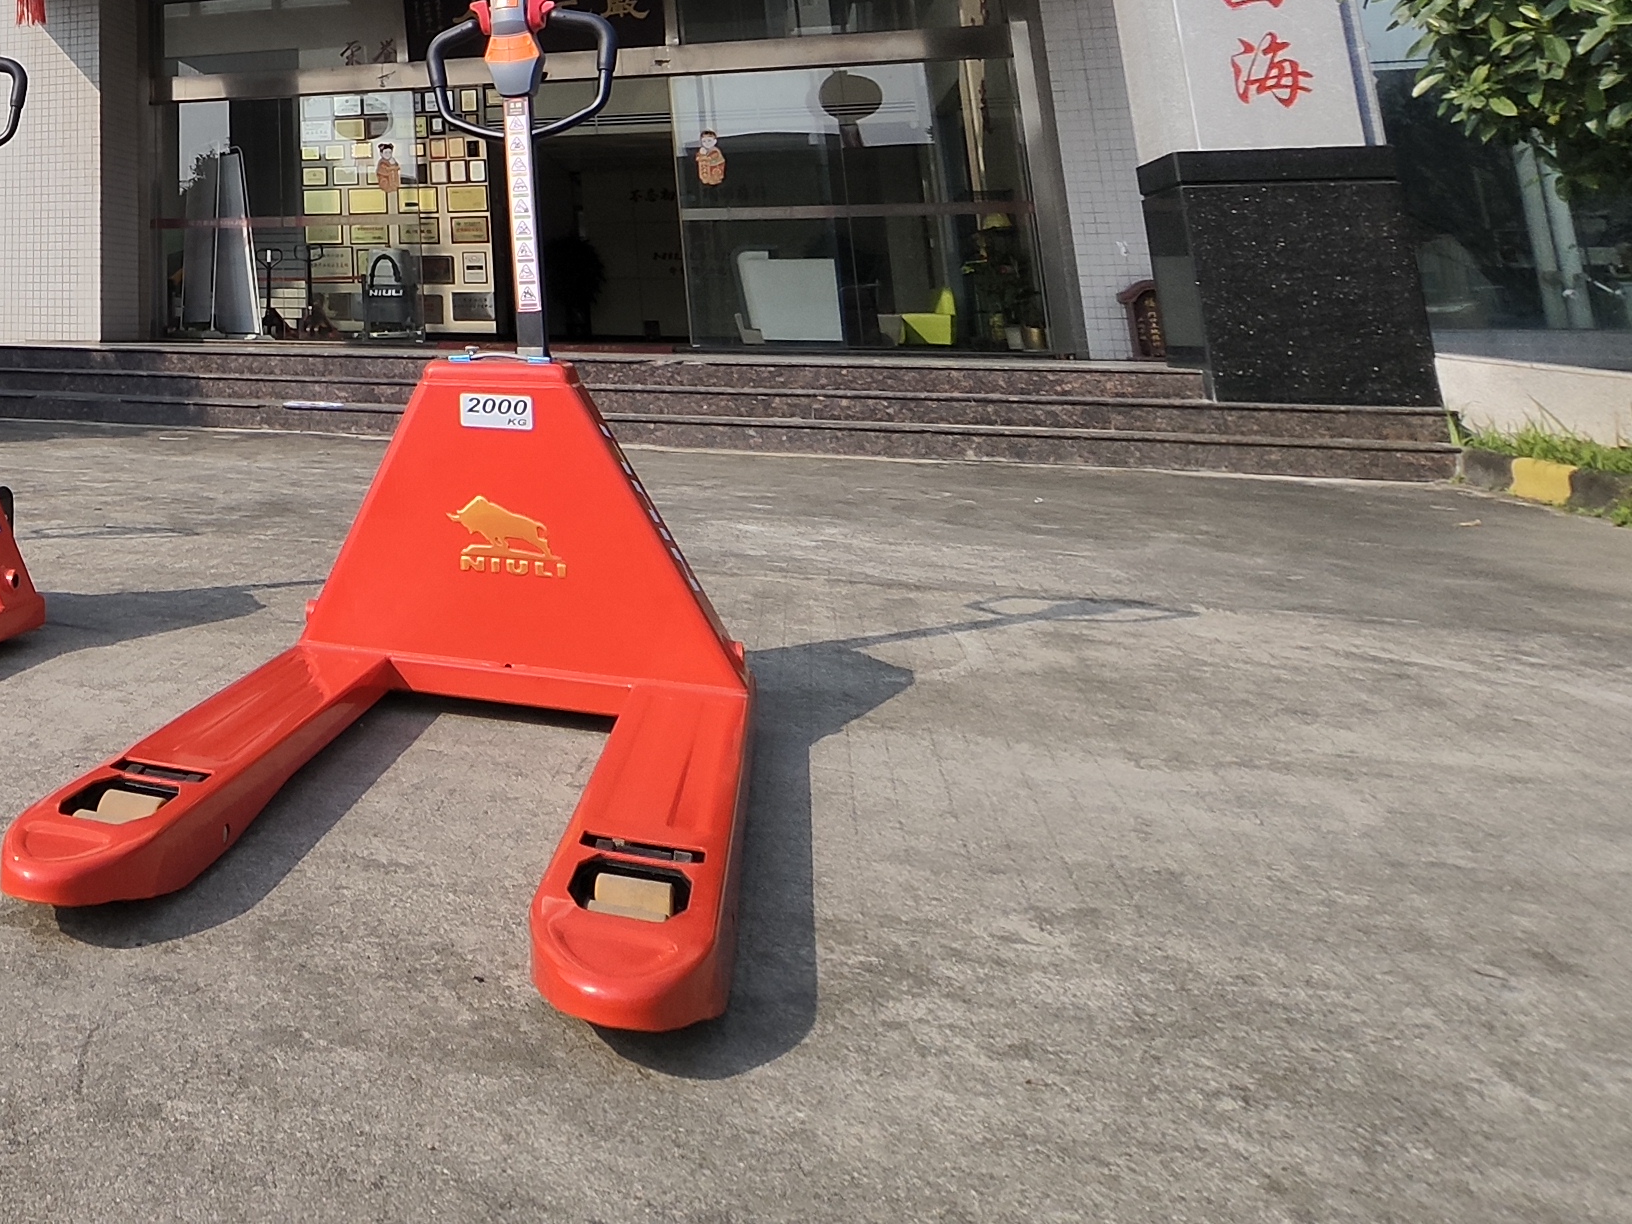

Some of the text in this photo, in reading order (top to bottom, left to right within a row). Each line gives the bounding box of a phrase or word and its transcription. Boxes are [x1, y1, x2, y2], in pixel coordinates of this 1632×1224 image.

[368, 288, 404, 297] NIULI
[467, 397, 528, 416] 2000
[507, 417, 527, 426] KG
[459, 554, 567, 579] NIULI
